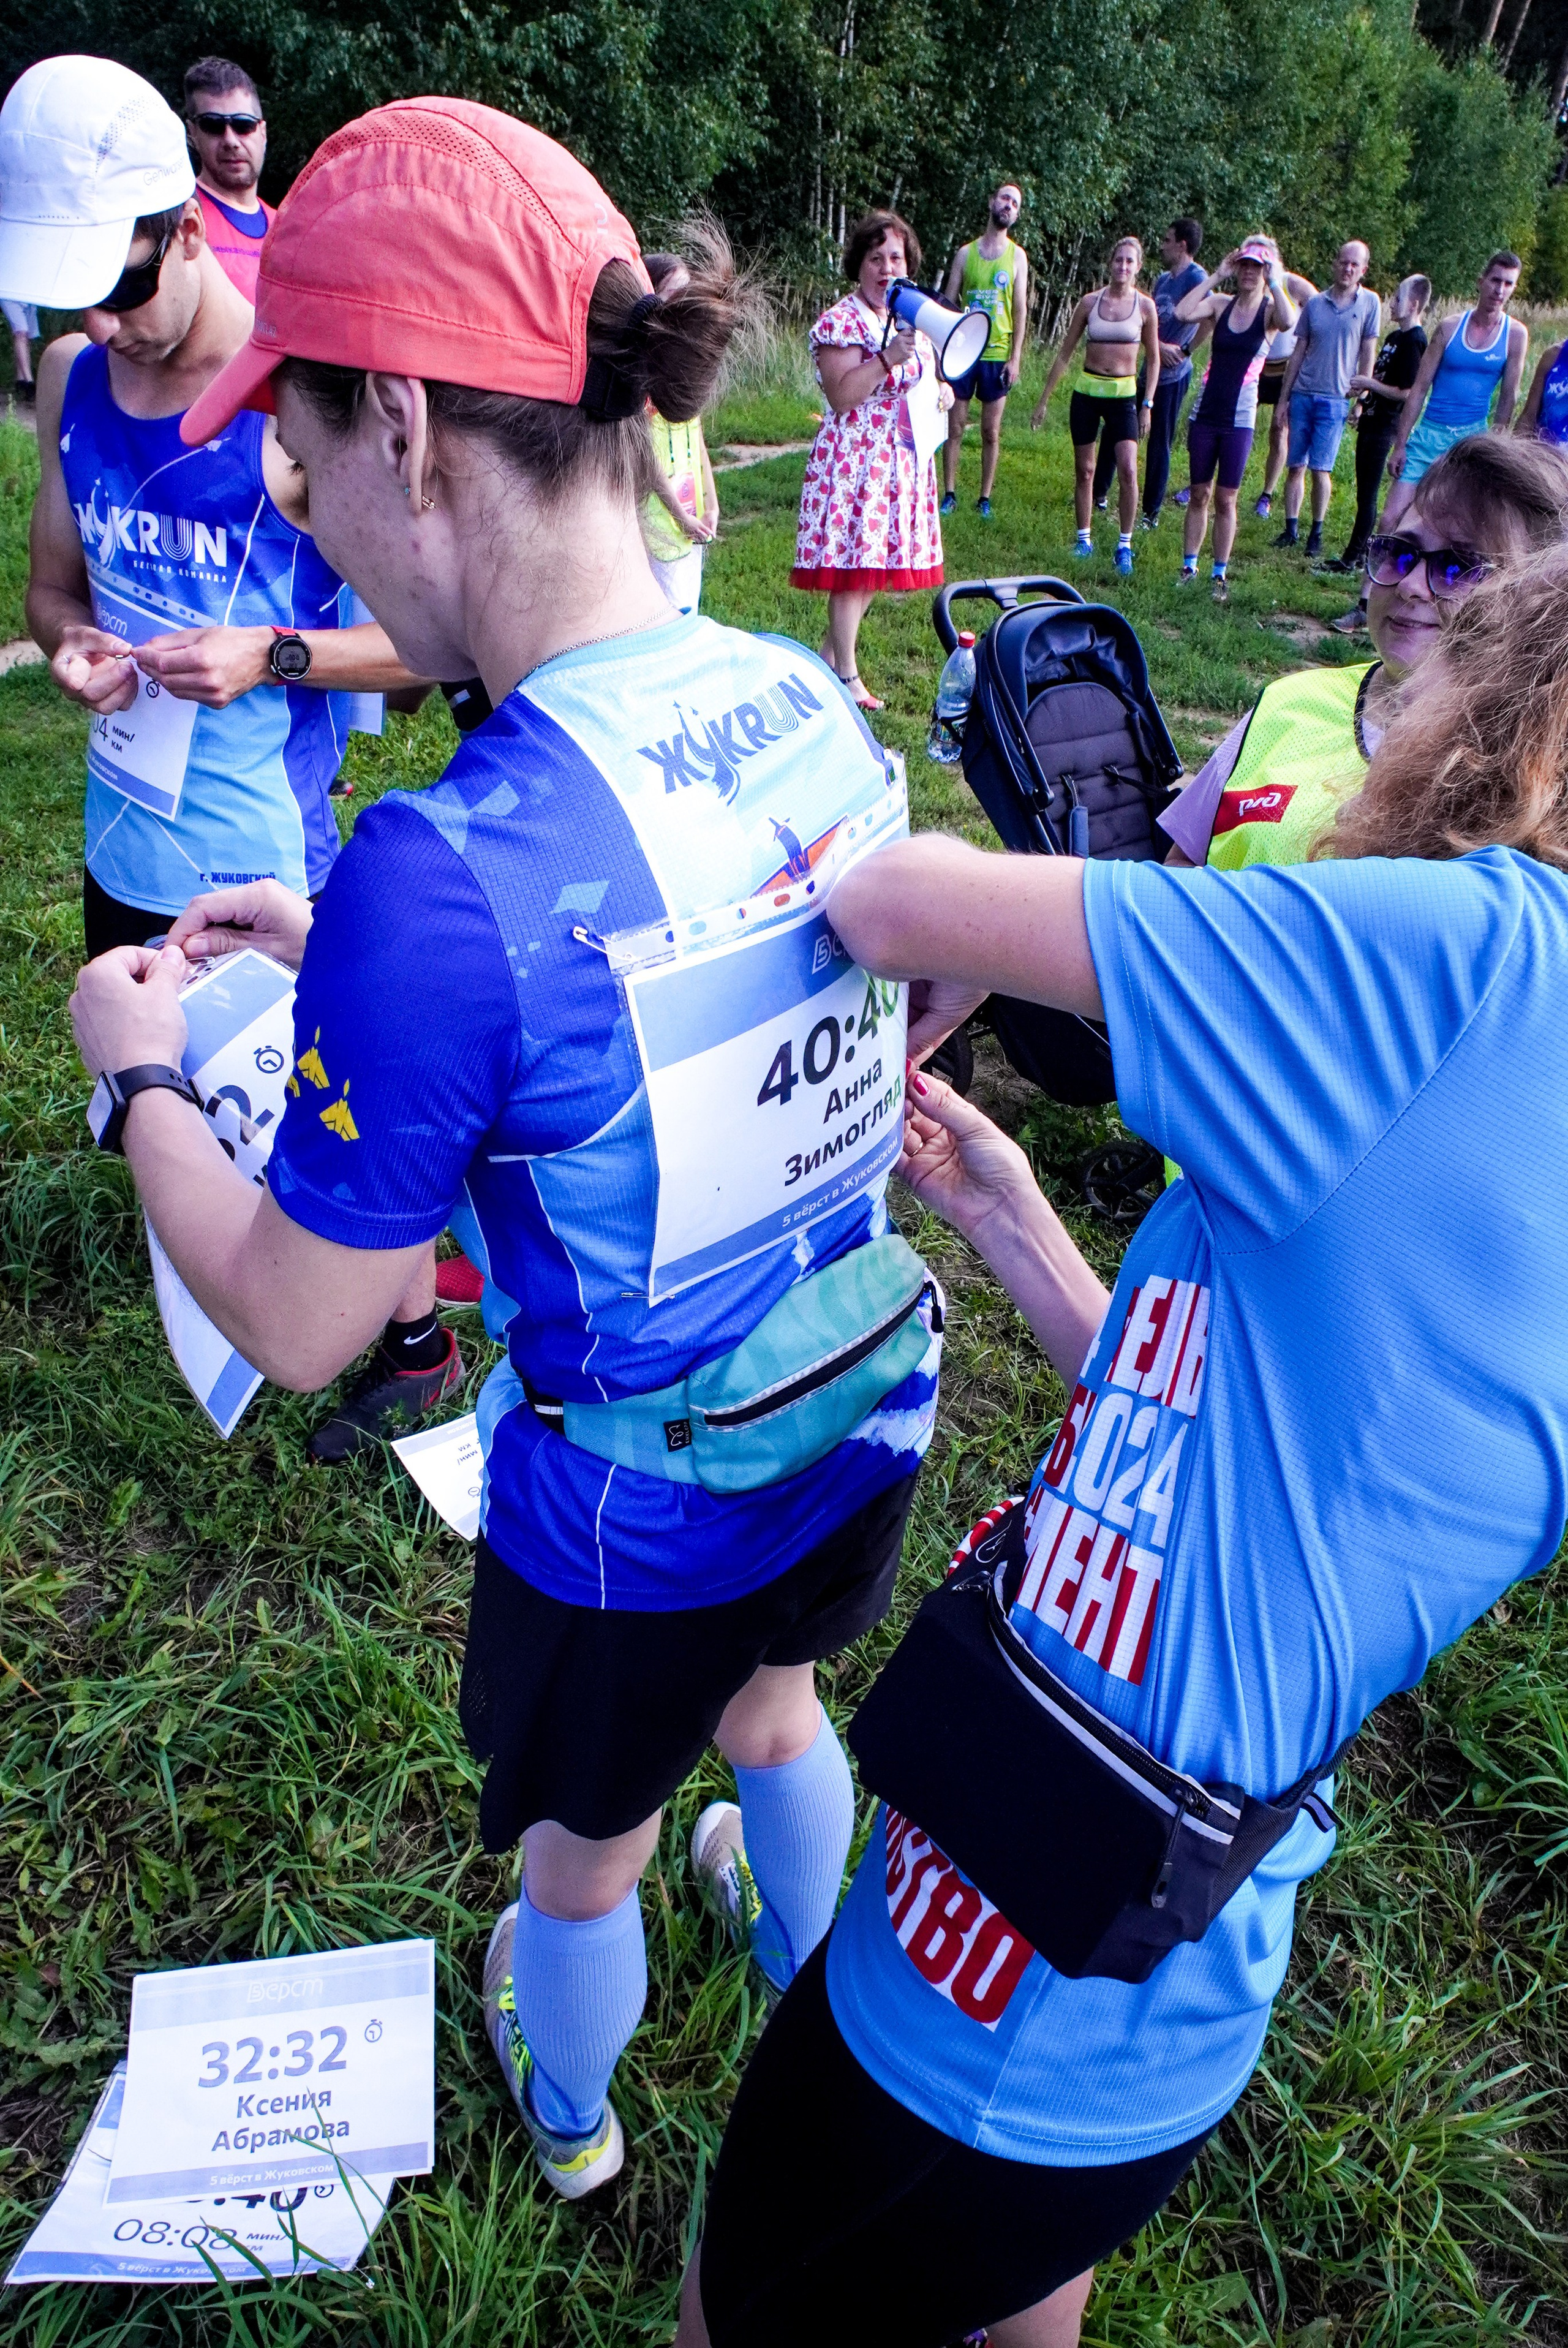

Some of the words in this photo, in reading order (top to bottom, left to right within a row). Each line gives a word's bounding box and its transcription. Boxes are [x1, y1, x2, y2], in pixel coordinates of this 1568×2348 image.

[179, 567, 227, 583] КОМАНДА
[111, 739, 123, 753] км
[112, 725, 135, 742] мин/
[757, 974, 899, 1107] 40:40
[823, 1058, 882, 1125] Анна
[785, 1074, 902, 1187] Зимогляд
[782, 1214, 791, 1228] 5
[793, 1193, 830, 1221] вёрст
[832, 1187, 840, 1199] в
[841, 1137, 899, 1193] Жуковском
[198, 2025, 348, 2088] 32:32
[237, 2089, 332, 2119] Ксения
[211, 2120, 350, 2154] Абрамова
[210, 2176, 218, 2186] 5
[219, 2173, 252, 2186] вёрст
[264, 2164, 334, 2181] Жуковском
[113, 2219, 238, 2250] 08:08
[116, 2262, 125, 2270] 5
[127, 2263, 161, 2274] вёрст
